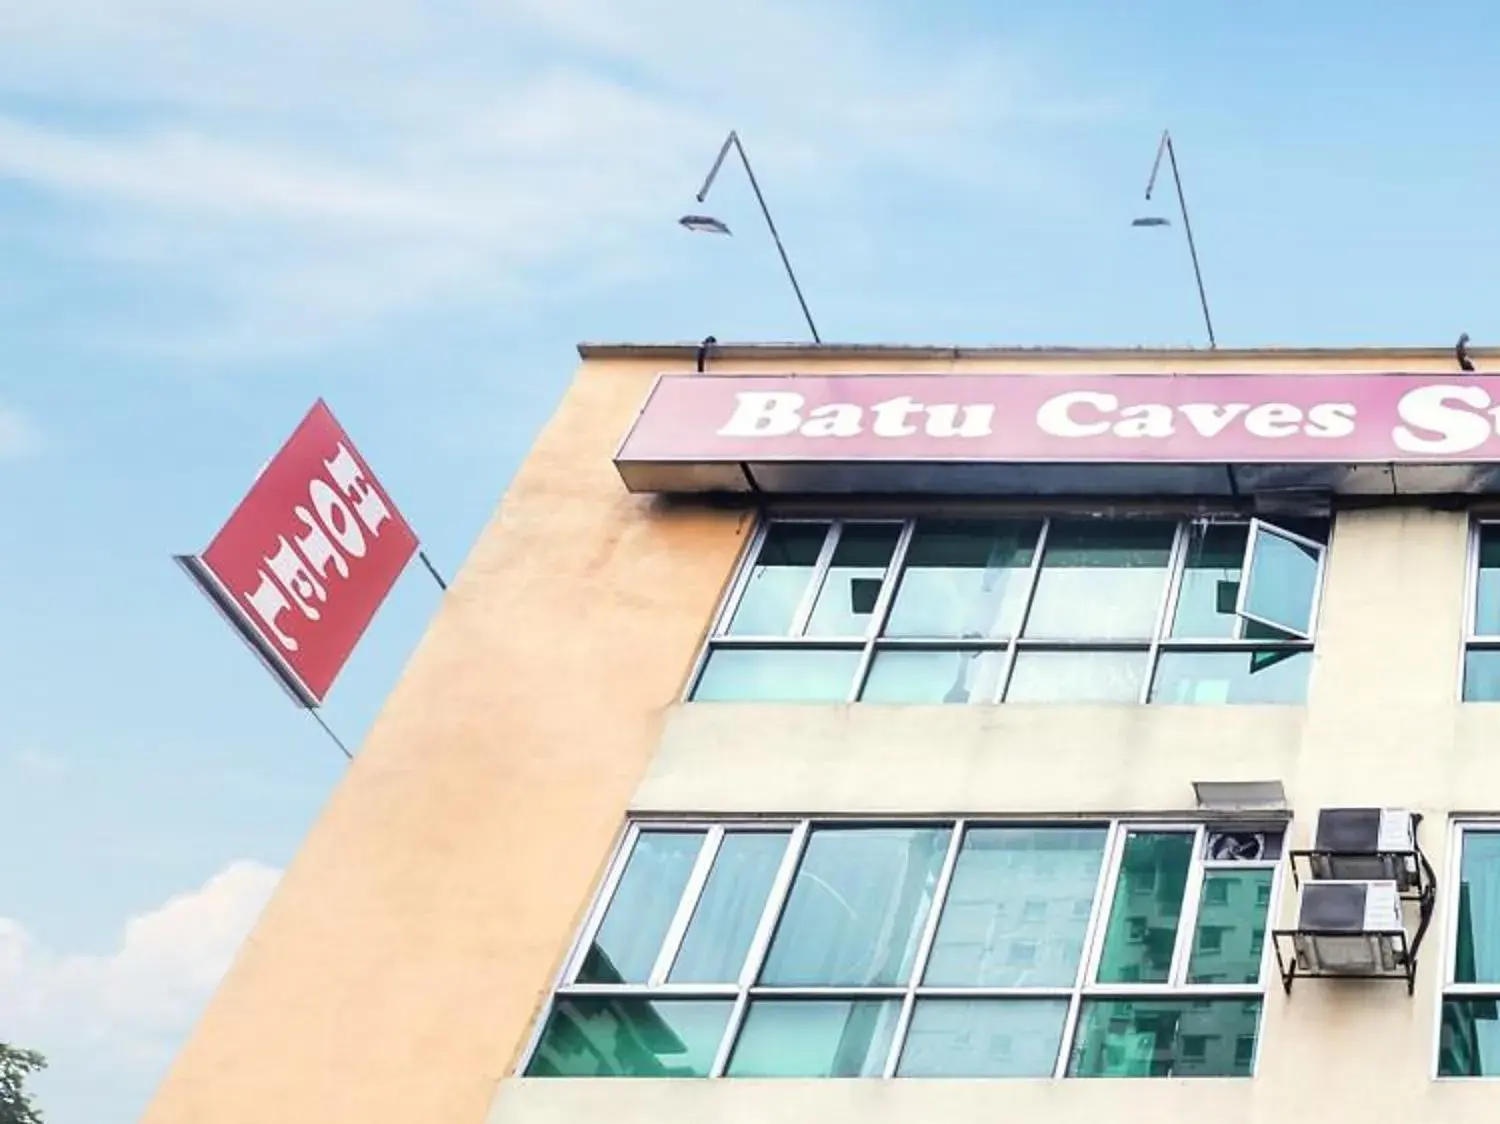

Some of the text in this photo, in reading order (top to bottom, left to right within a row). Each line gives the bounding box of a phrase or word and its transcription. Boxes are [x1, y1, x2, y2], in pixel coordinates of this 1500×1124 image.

[717, 392, 995, 438] Batu
[1035, 392, 1356, 439] Caves
[243, 440, 392, 652] HOTEL
